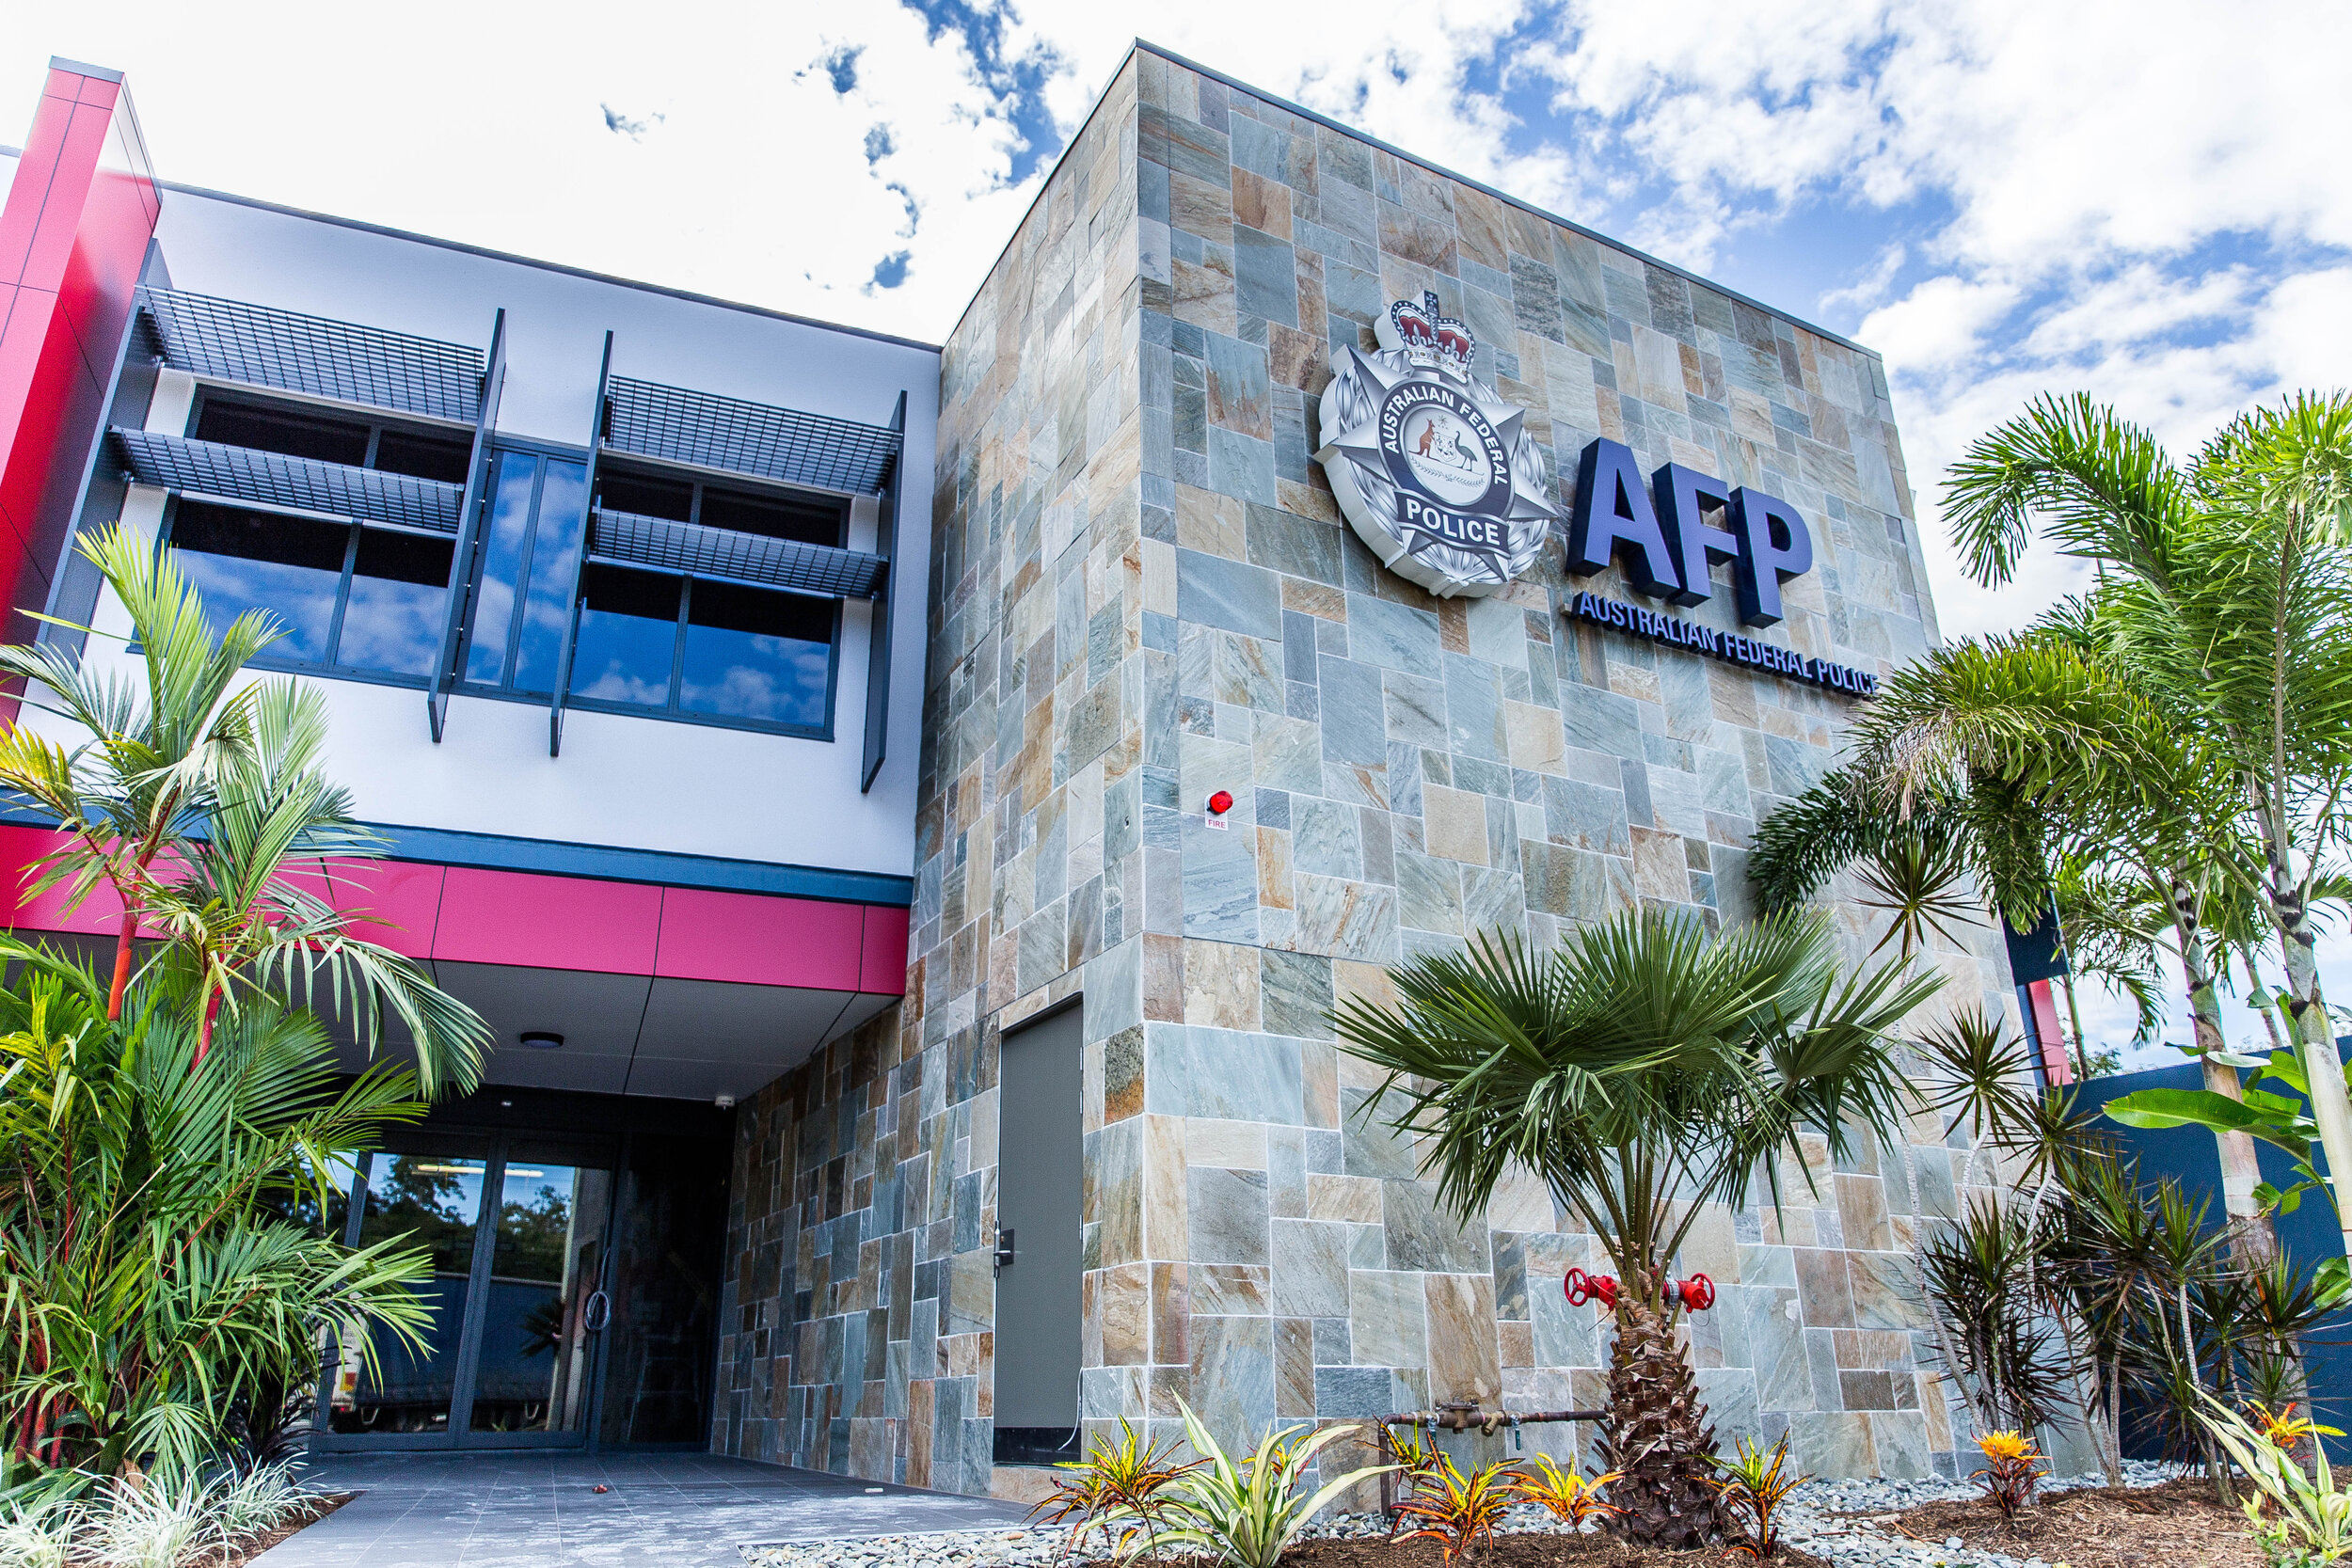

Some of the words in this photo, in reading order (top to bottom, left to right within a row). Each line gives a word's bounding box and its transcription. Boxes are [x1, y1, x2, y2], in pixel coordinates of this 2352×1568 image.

[1384, 385, 1454, 454] AUSTRALIAN
[1459, 403, 1508, 485] FEDERAL
[1406, 498, 1501, 546] POLICE
[1581, 436, 1813, 625] AFP
[1578, 591, 1719, 653] AUSTRALIAN
[1723, 631, 1813, 679] FEDERAL
[1815, 657, 1880, 696] POLICE
[1208, 819, 1226, 829] FIRE
